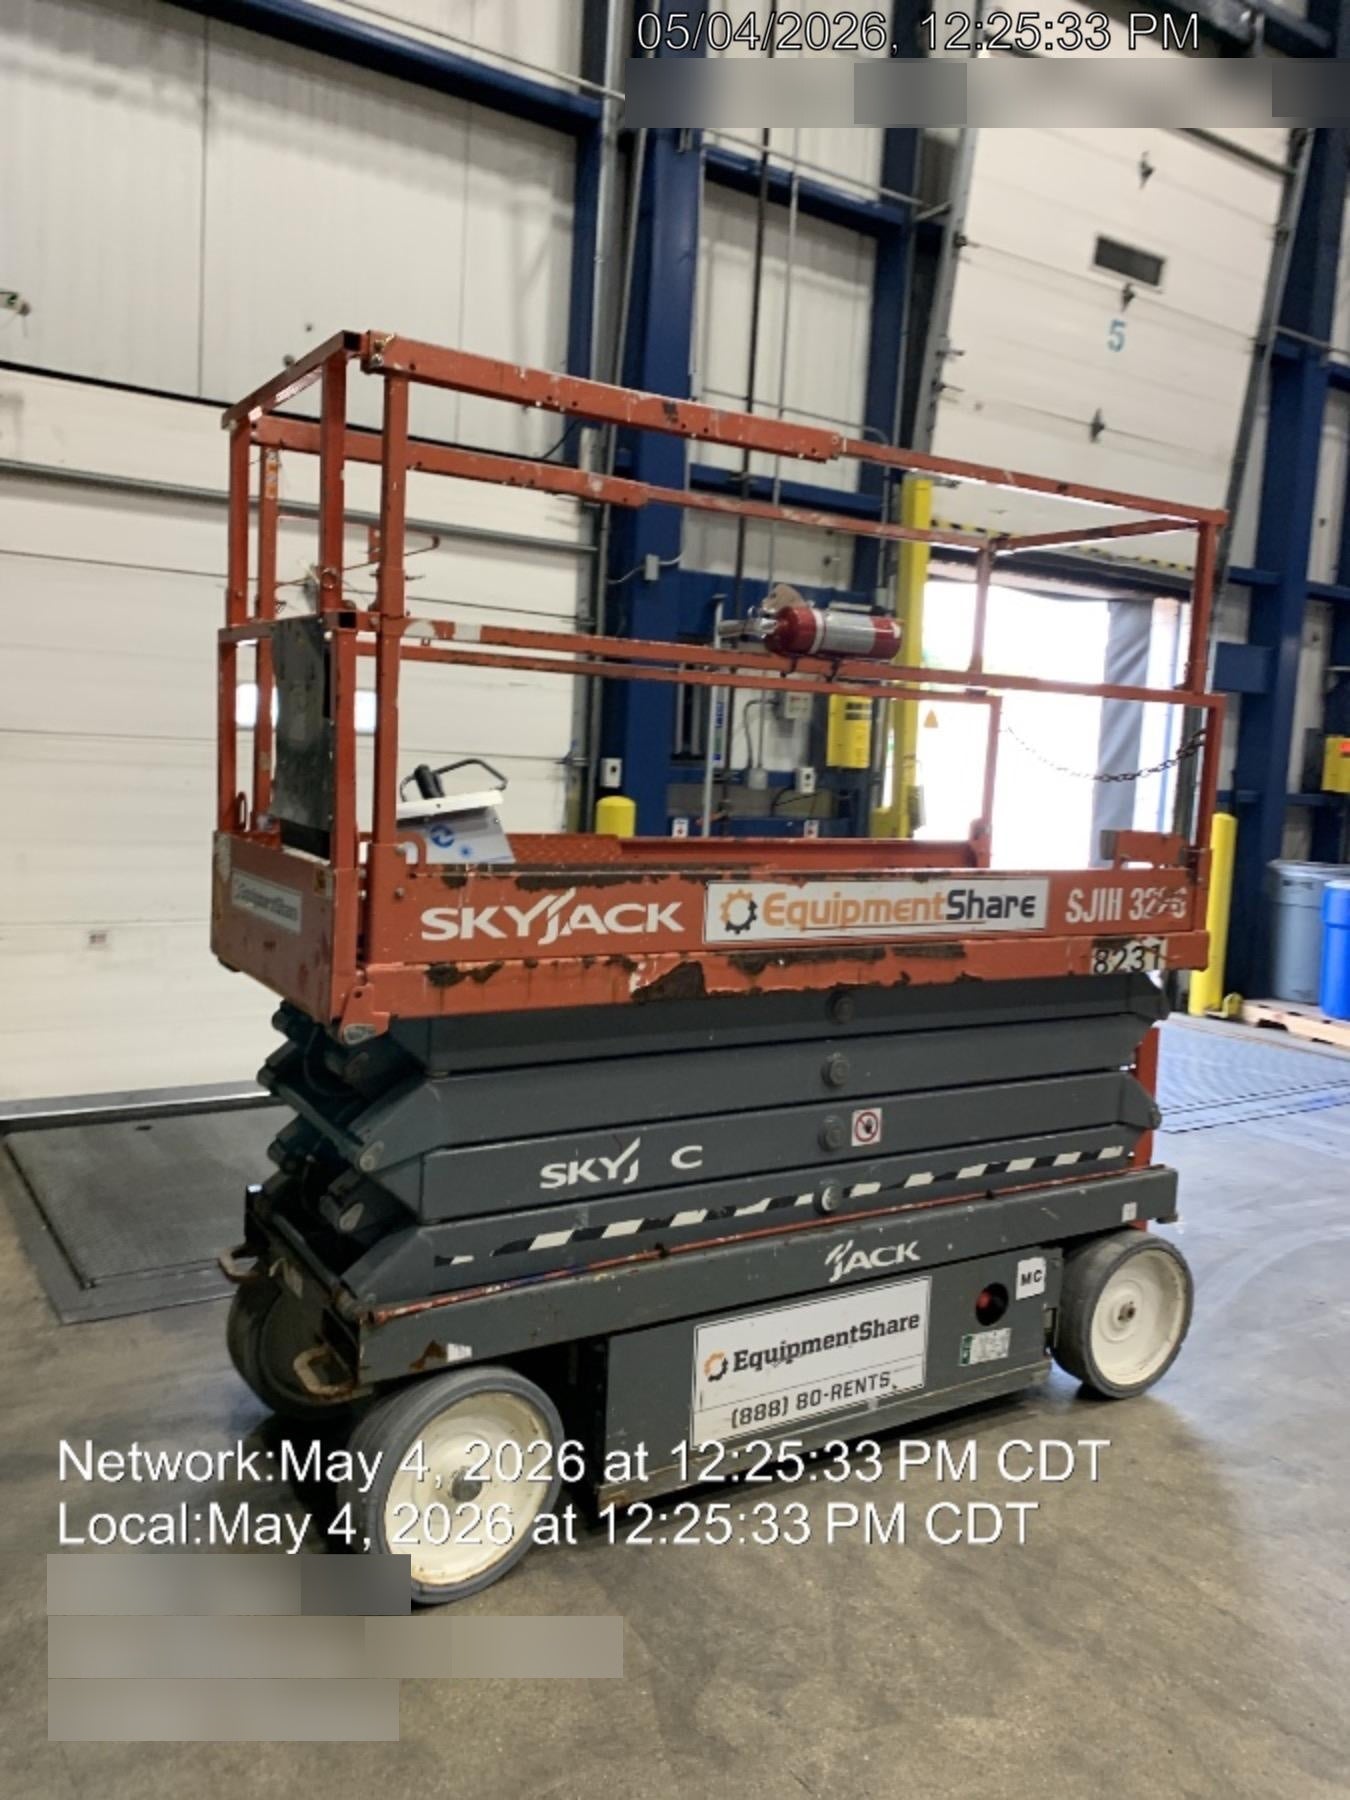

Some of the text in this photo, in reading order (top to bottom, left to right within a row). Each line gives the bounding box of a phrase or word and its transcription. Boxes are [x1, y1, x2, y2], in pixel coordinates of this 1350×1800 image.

[1107, 319, 1126, 353] 5
[420, 887, 685, 945] SKYJACK
[762, 889, 1036, 930] EquipmentShare
[1021, 1269, 1042, 1287] MC
[733, 1314, 920, 1372] EquipmentShare
[731, 1396, 788, 1428] (888)
